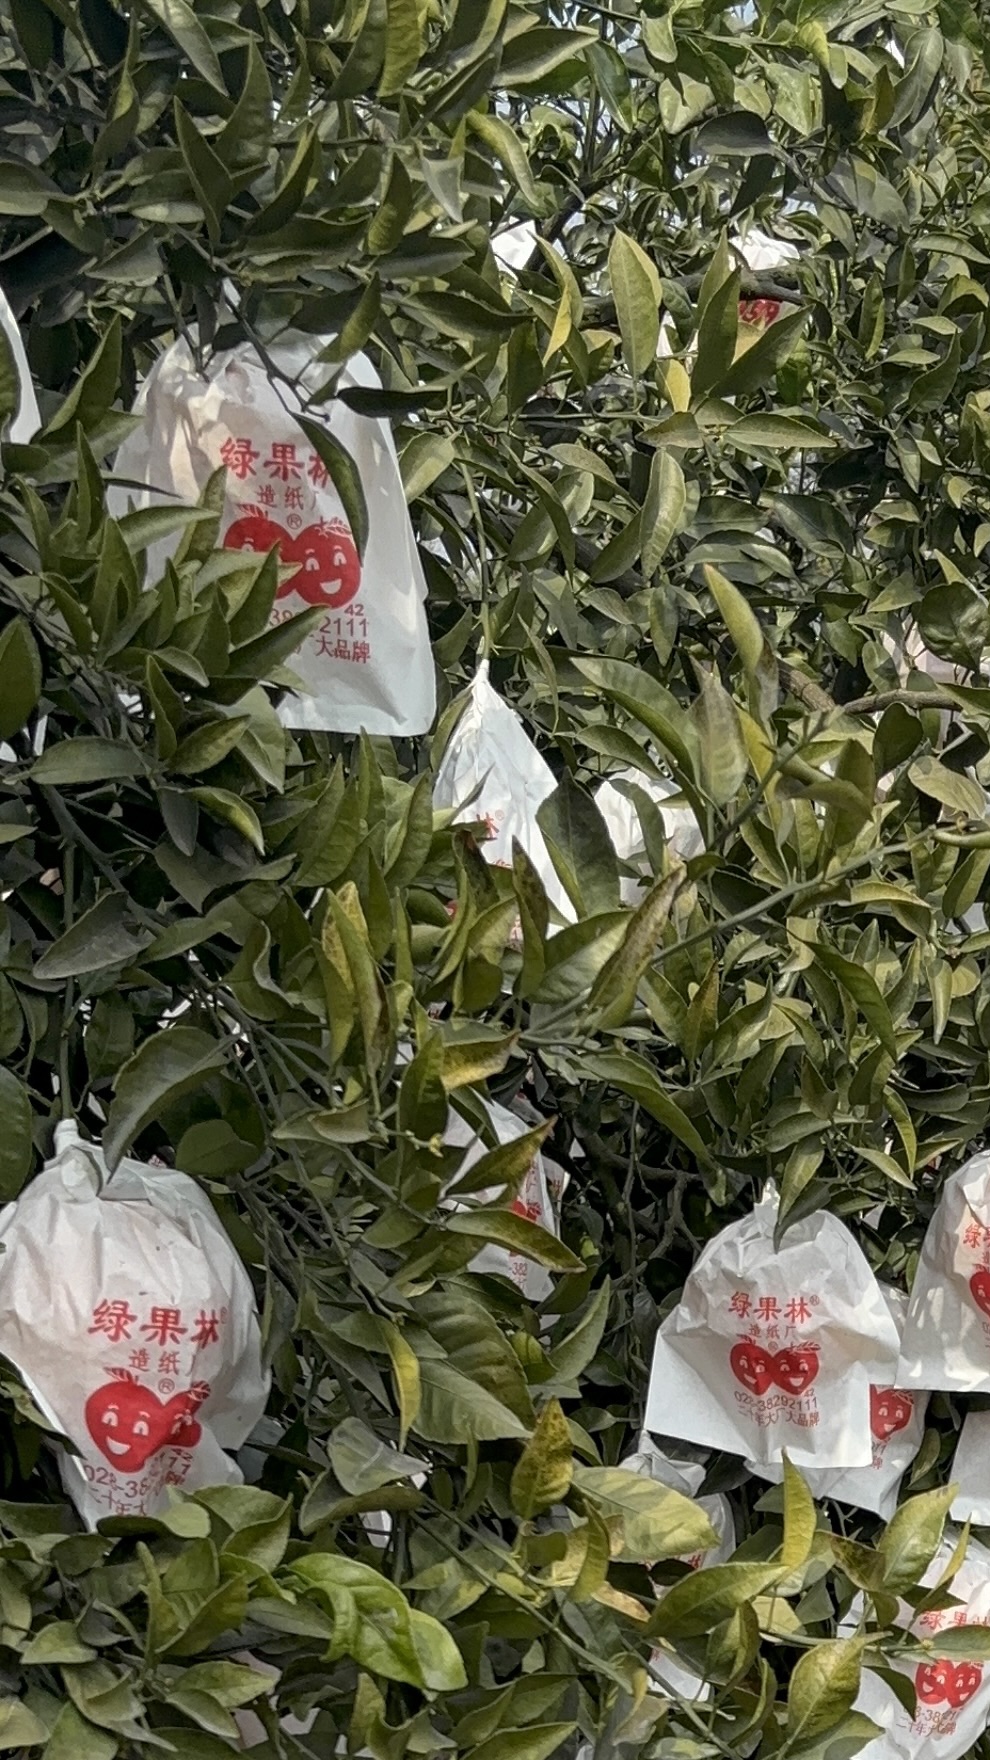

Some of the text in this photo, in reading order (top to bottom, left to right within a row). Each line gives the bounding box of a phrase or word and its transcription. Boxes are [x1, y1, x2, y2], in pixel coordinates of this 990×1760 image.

[344, 604, 364, 616] 42
[310, 636, 371, 664] 大品牌
[728, 1291, 812, 1324] 绿果林
[87, 1299, 219, 1349] 绿果林
[749, 1324, 797, 1340] 造纸厂
